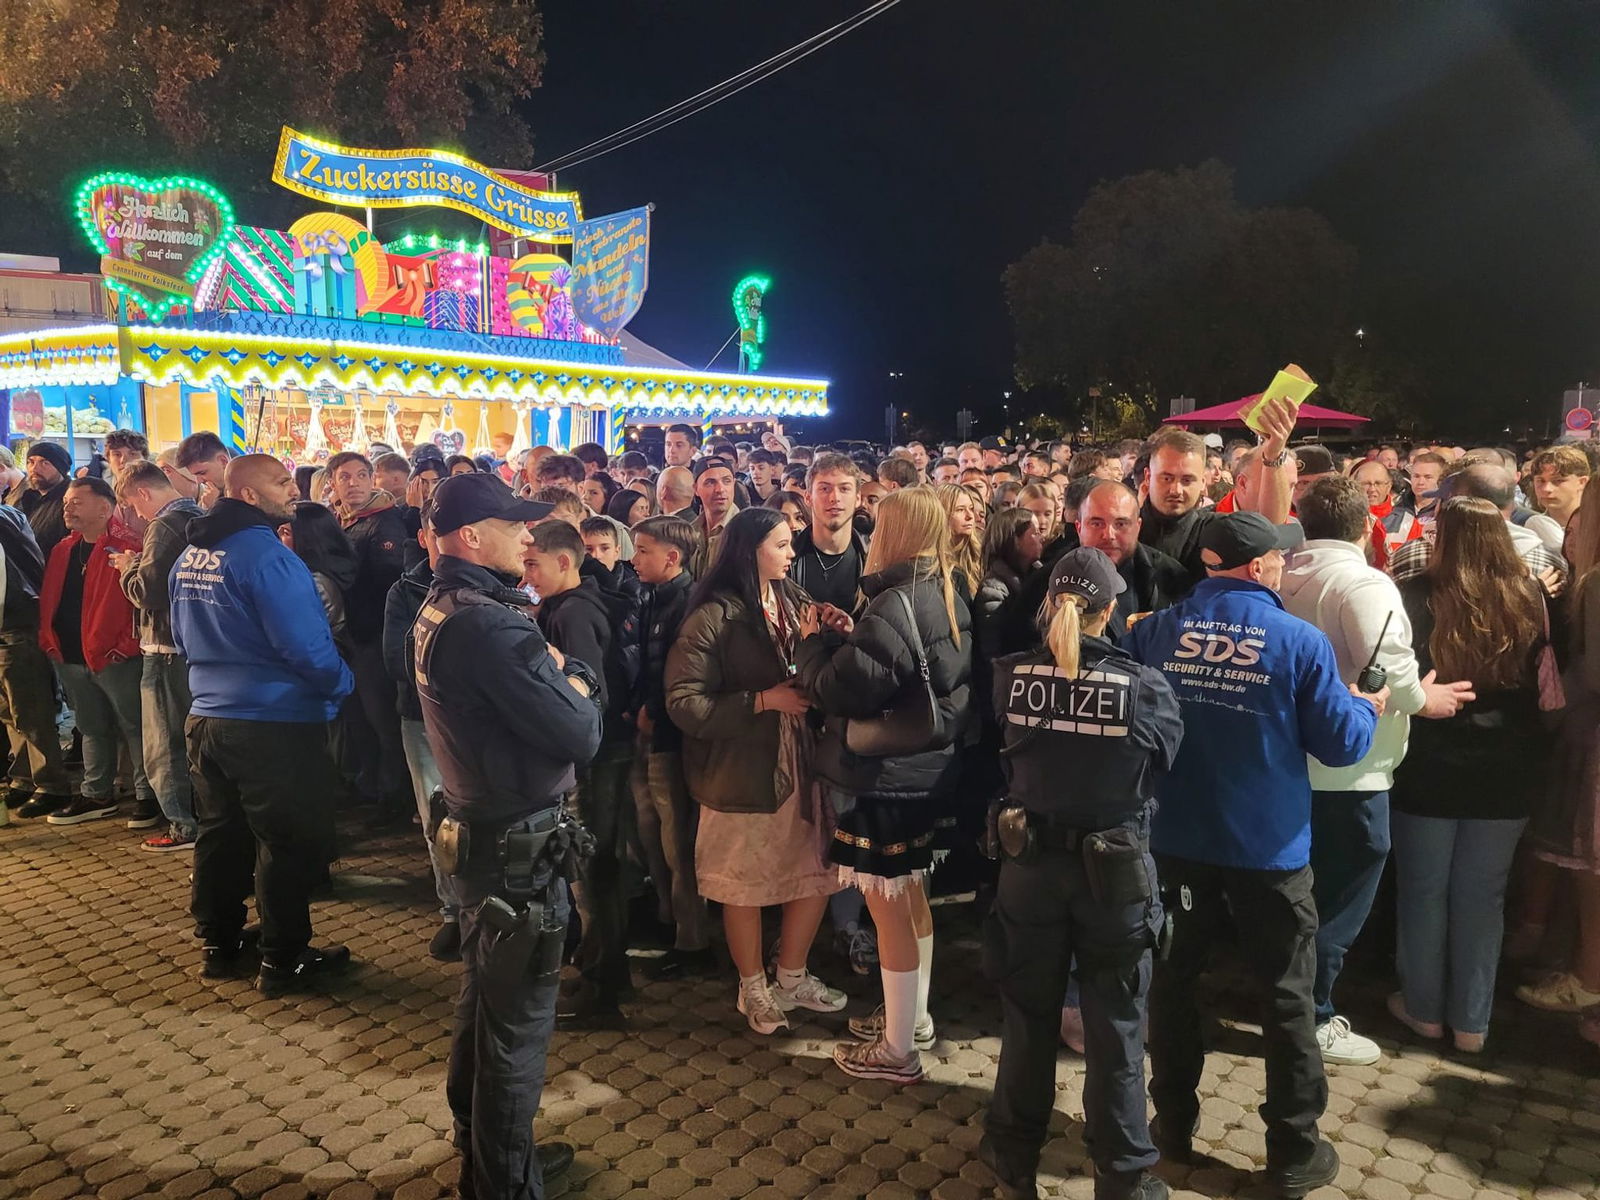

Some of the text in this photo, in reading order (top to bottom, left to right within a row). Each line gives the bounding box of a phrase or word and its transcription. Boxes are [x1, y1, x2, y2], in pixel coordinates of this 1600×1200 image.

[300, 149, 569, 229] Zuckersüsse Grüsse
[119, 195, 189, 224] Herzlich
[106, 219, 204, 247] Willkommen
[147, 249, 183, 261] auf dem
[574, 233, 646, 282] Mandeln
[181, 547, 226, 570] SDS
[1055, 575, 1099, 596] POLIZEI
[1183, 620, 1267, 637] IM AUFTRAG VON
[1174, 631, 1266, 666] SDS
[1163, 661, 1272, 686] SECURITY & SERVICE
[1181, 678, 1246, 693] www.sds-bw.de
[1008, 679, 1126, 721] POLIZEI
